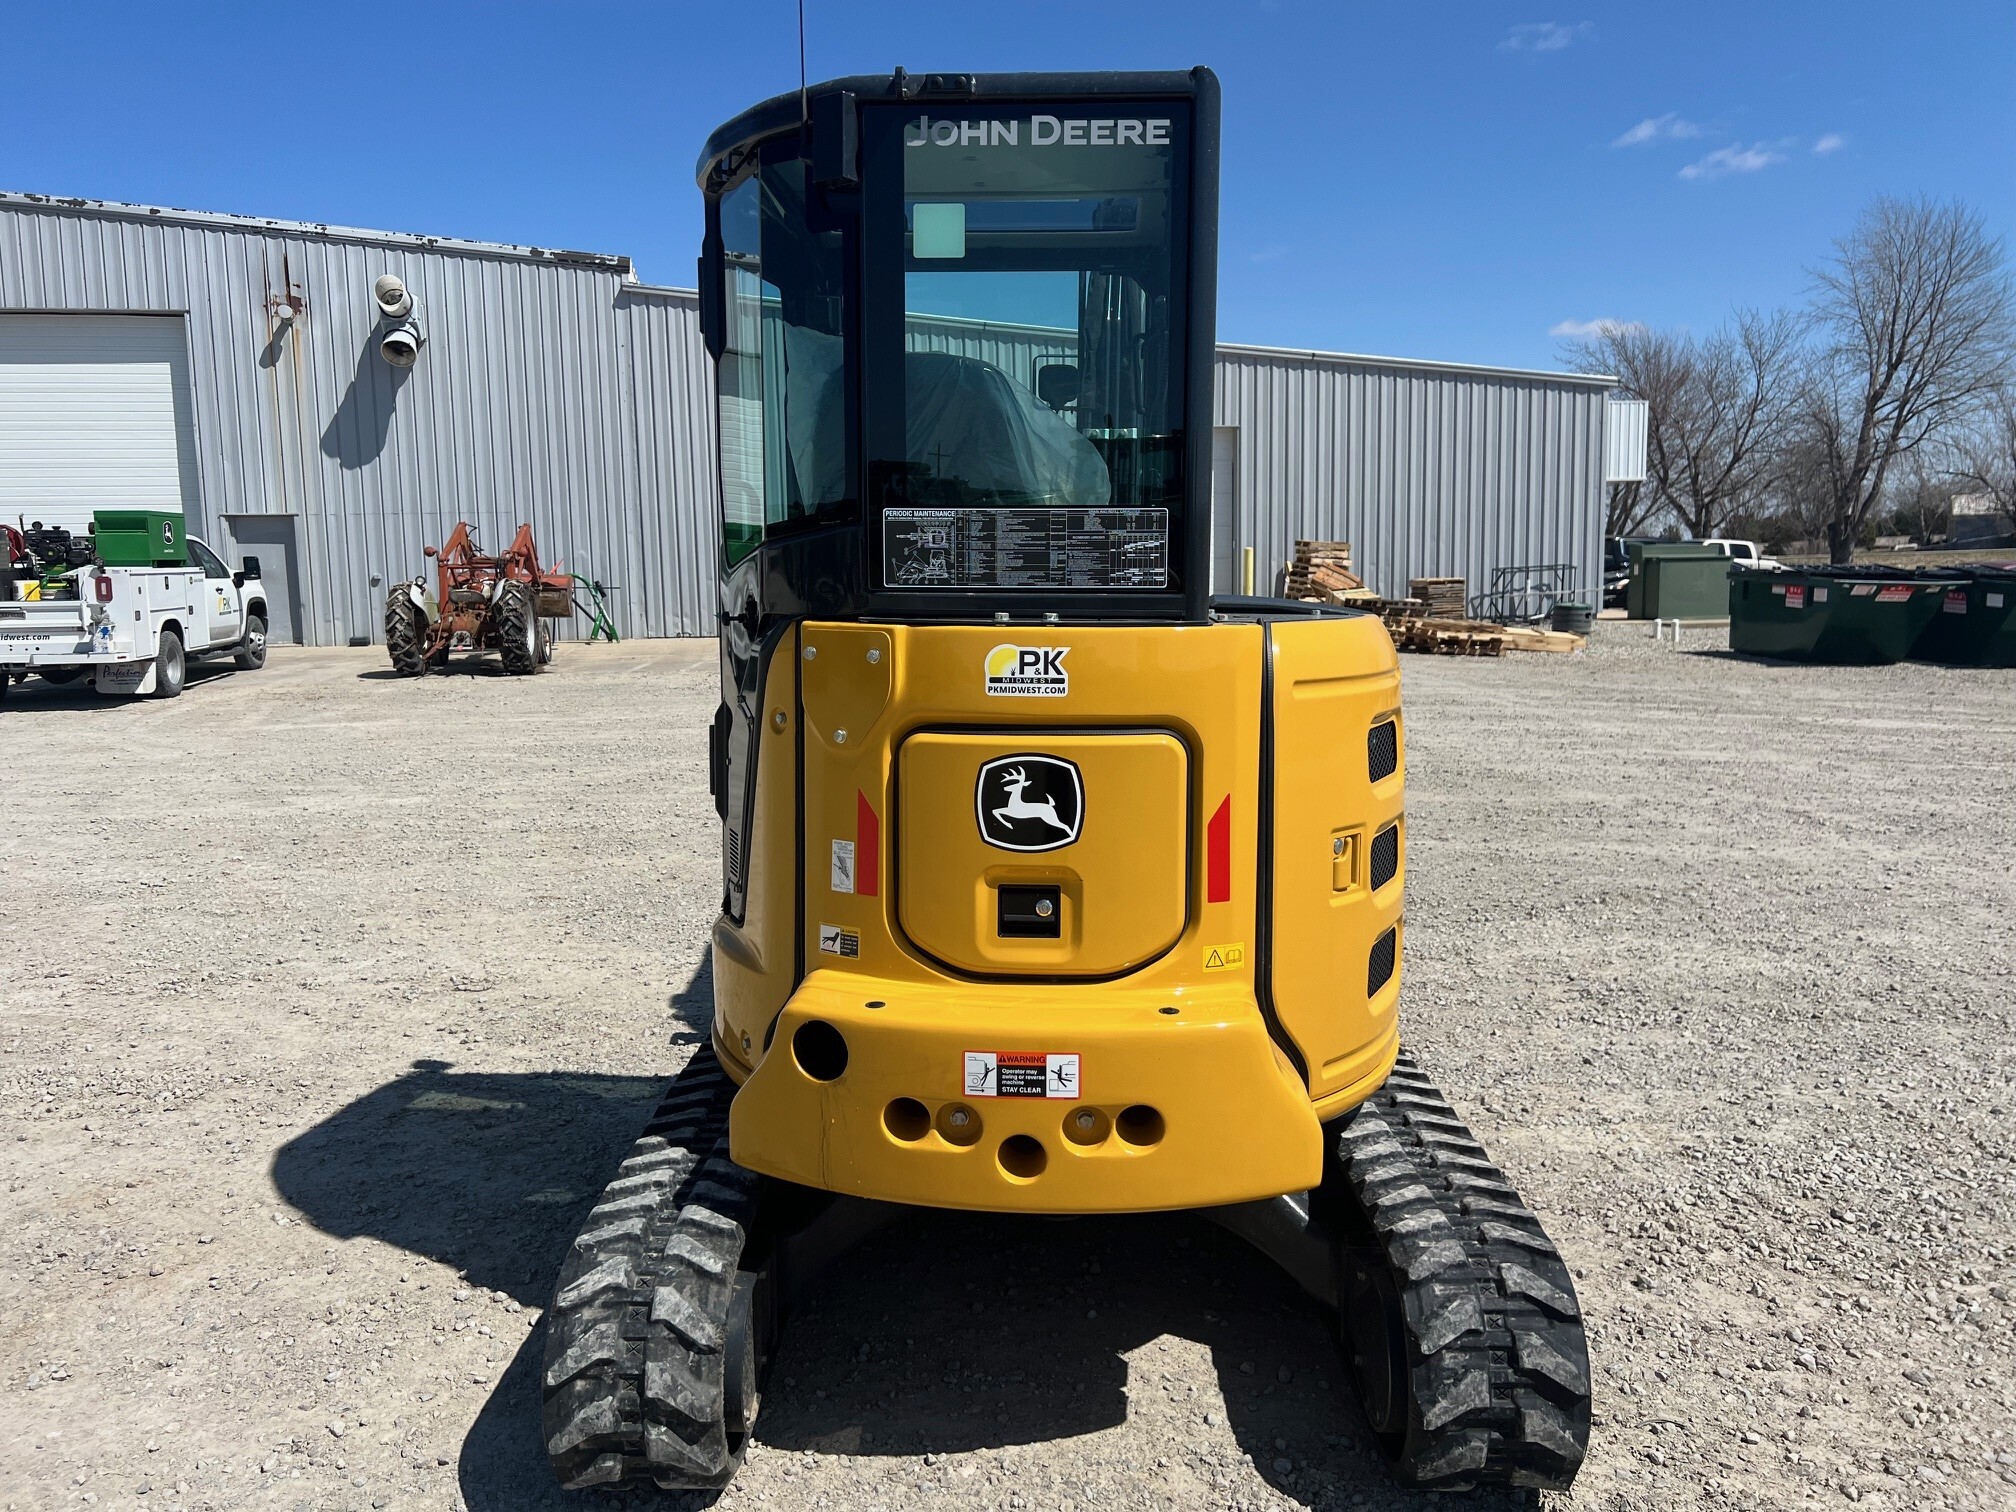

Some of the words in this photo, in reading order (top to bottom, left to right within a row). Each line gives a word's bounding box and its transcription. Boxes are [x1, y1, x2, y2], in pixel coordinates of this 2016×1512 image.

[906, 115, 1018, 146] JOHN
[1031, 115, 1170, 146] DEERE
[987, 686, 1066, 694] PKMIDWEST.COM
[1007, 1055, 1046, 1064] WARNING
